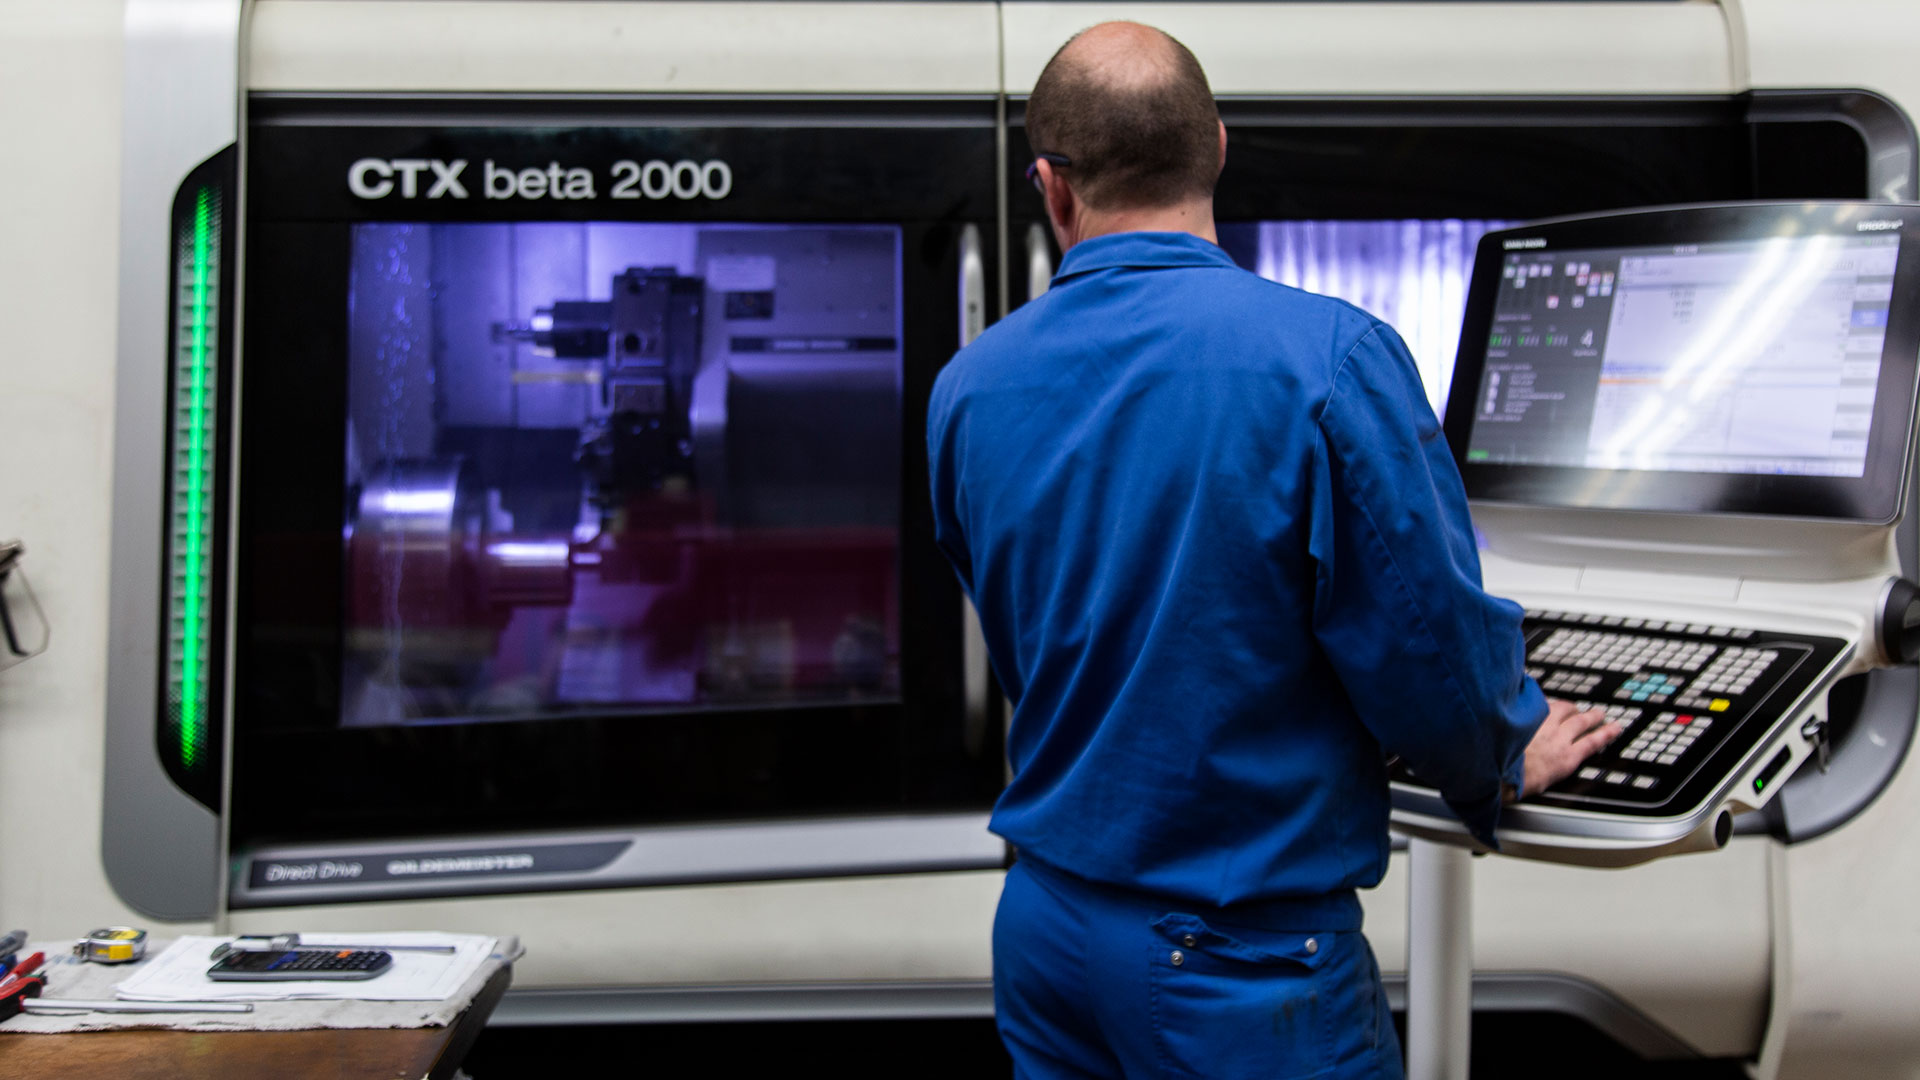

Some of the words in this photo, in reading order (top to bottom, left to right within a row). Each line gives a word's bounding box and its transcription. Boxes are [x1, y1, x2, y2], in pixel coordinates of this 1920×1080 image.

[348, 158, 469, 199] CTX
[484, 160, 597, 199] beta
[610, 160, 733, 199] 2000
[318, 861, 363, 879] Drive
